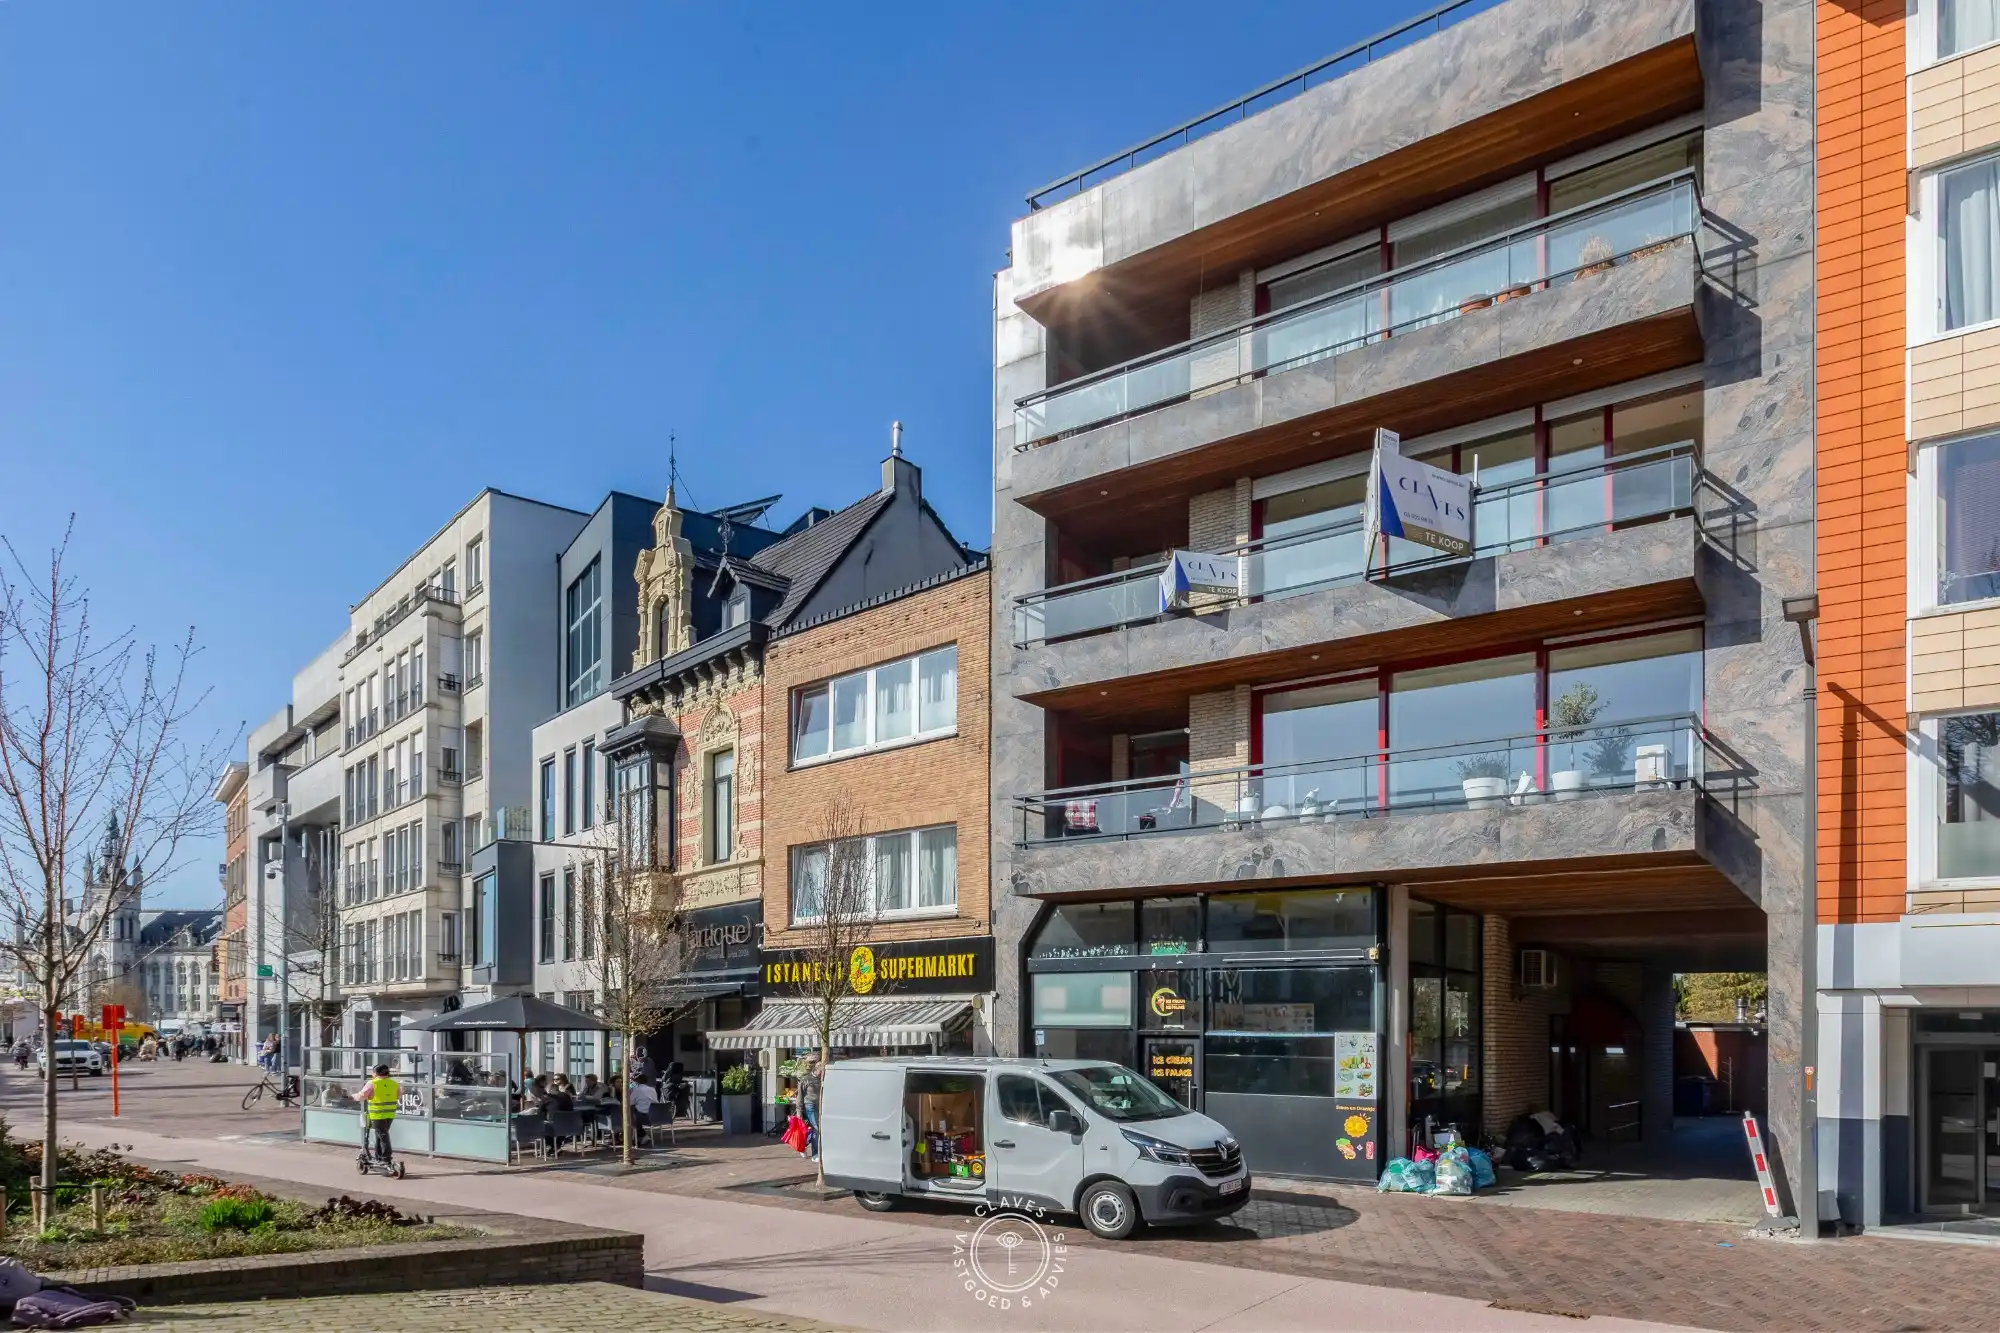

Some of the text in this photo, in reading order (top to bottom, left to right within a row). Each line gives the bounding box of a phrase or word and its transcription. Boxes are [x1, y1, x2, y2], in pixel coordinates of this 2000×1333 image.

[1425, 532, 1464, 551] TE KOOP
[880, 953, 975, 980] SUPERMARKT
[1153, 1056, 1192, 1064] ICE CREAM
[1153, 1068, 1192, 1077] ICE PALACE
